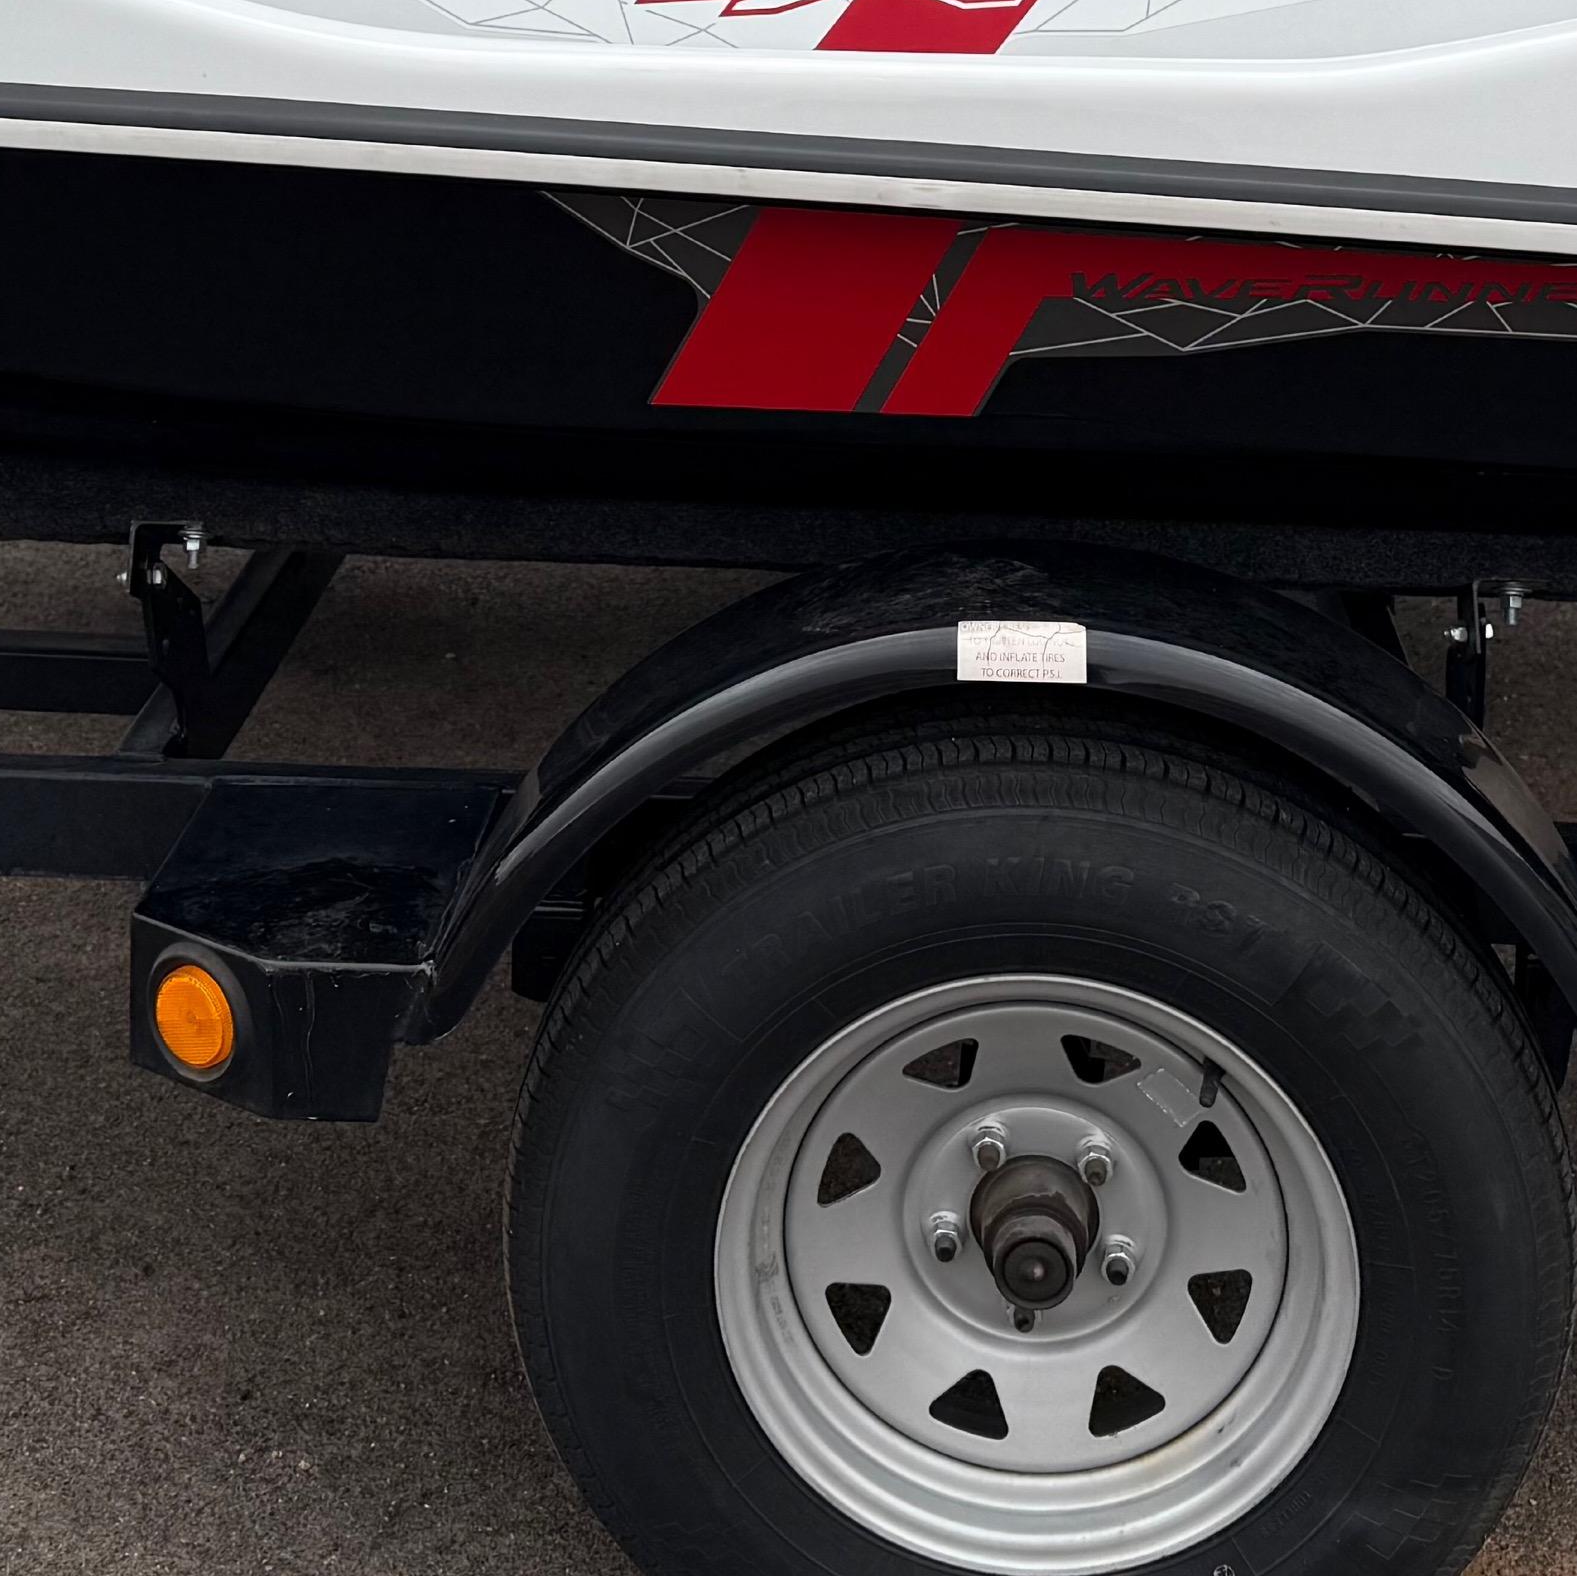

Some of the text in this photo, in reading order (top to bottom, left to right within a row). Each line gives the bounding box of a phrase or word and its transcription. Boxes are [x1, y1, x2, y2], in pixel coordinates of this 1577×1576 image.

[975, 651, 999, 663] AND
[999, 652, 1039, 664] INFLATE
[980, 668, 995, 679] TO
[996, 668, 1042, 680] CORRECT
[716, 863, 960, 976] TRAILER
[981, 855, 1138, 908] KING
